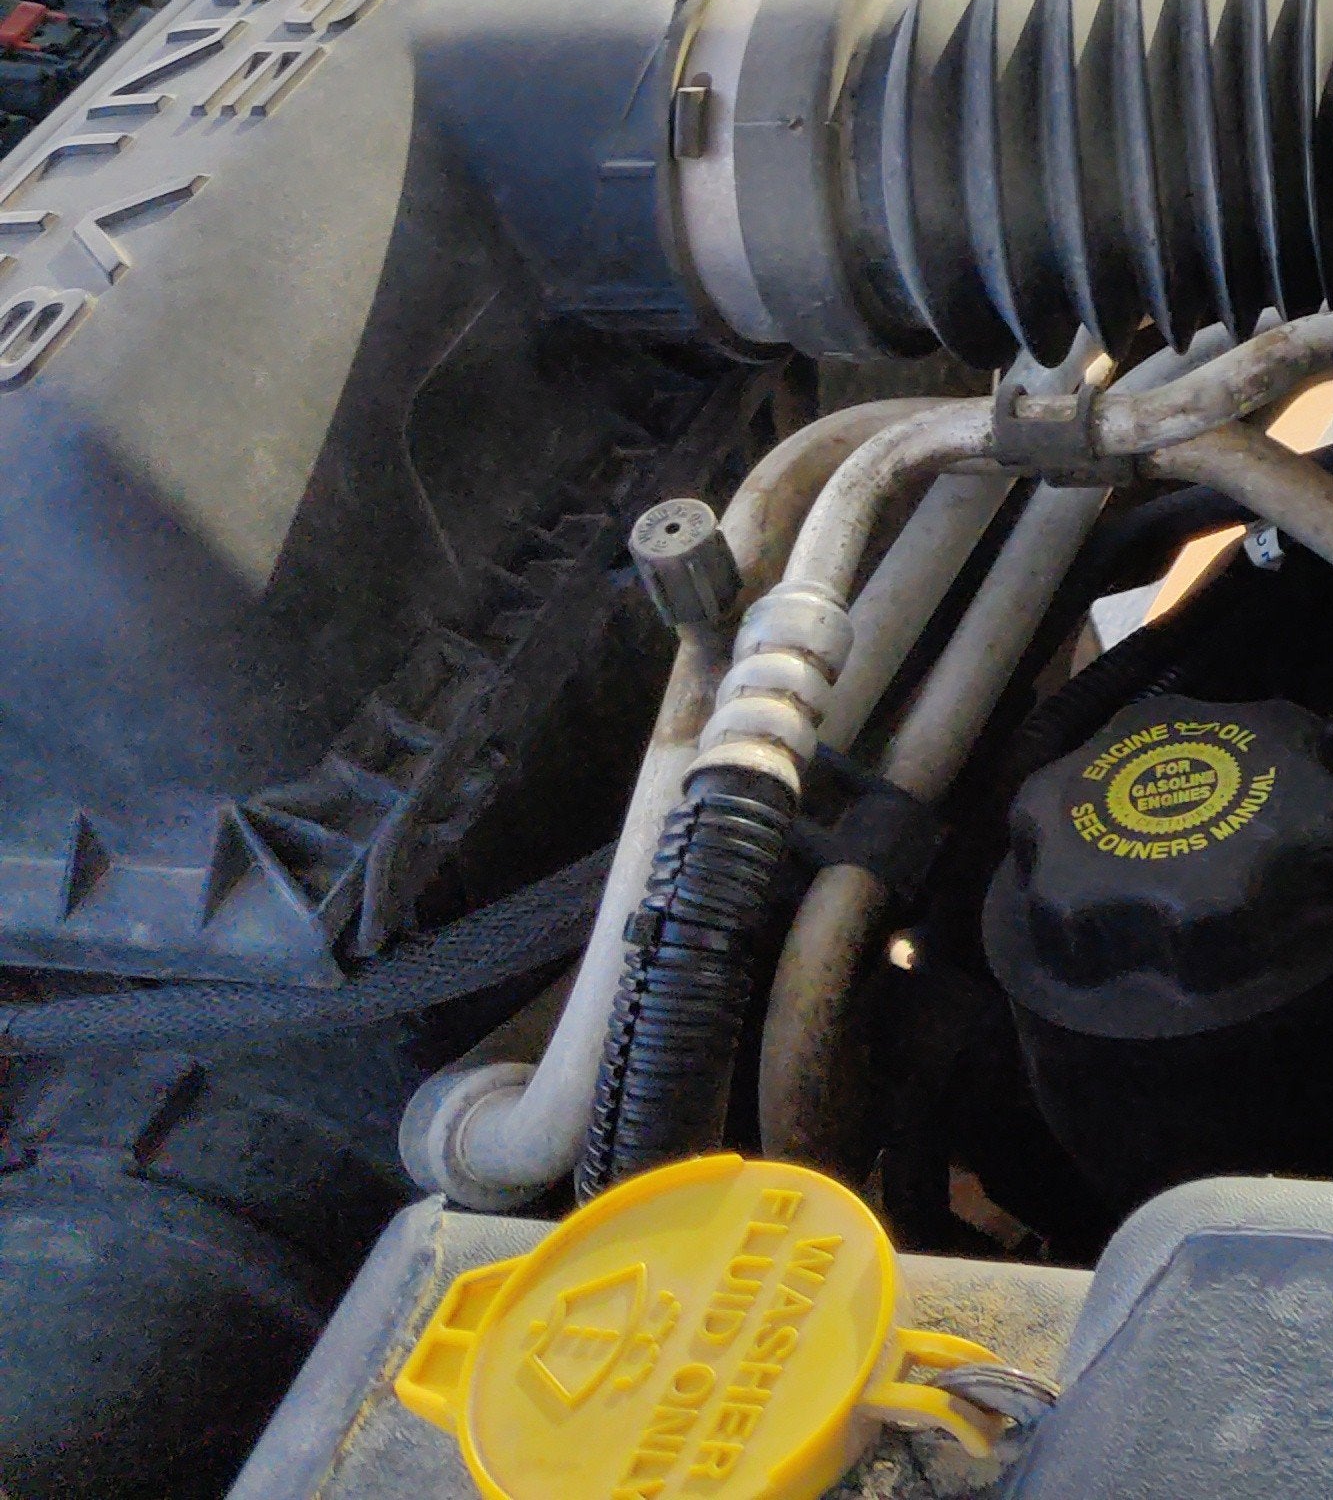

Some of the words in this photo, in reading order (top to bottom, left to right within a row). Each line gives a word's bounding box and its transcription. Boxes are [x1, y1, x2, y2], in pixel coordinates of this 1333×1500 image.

[1081, 723, 1170, 781] ENGINE
[1217, 723, 1257, 753] OIL
[1155, 760, 1192, 779] FOR
[1070, 802, 1108, 843] SEE
[1097, 833, 1209, 860] OWNERS
[1208, 766, 1277, 841] MANUAL
[1131, 769, 1217, 799] GASOLINE
[1136, 785, 1213, 812] ENGINES
[699, 1188, 804, 1346] FLUID
[687, 1234, 843, 1480] WASHER
